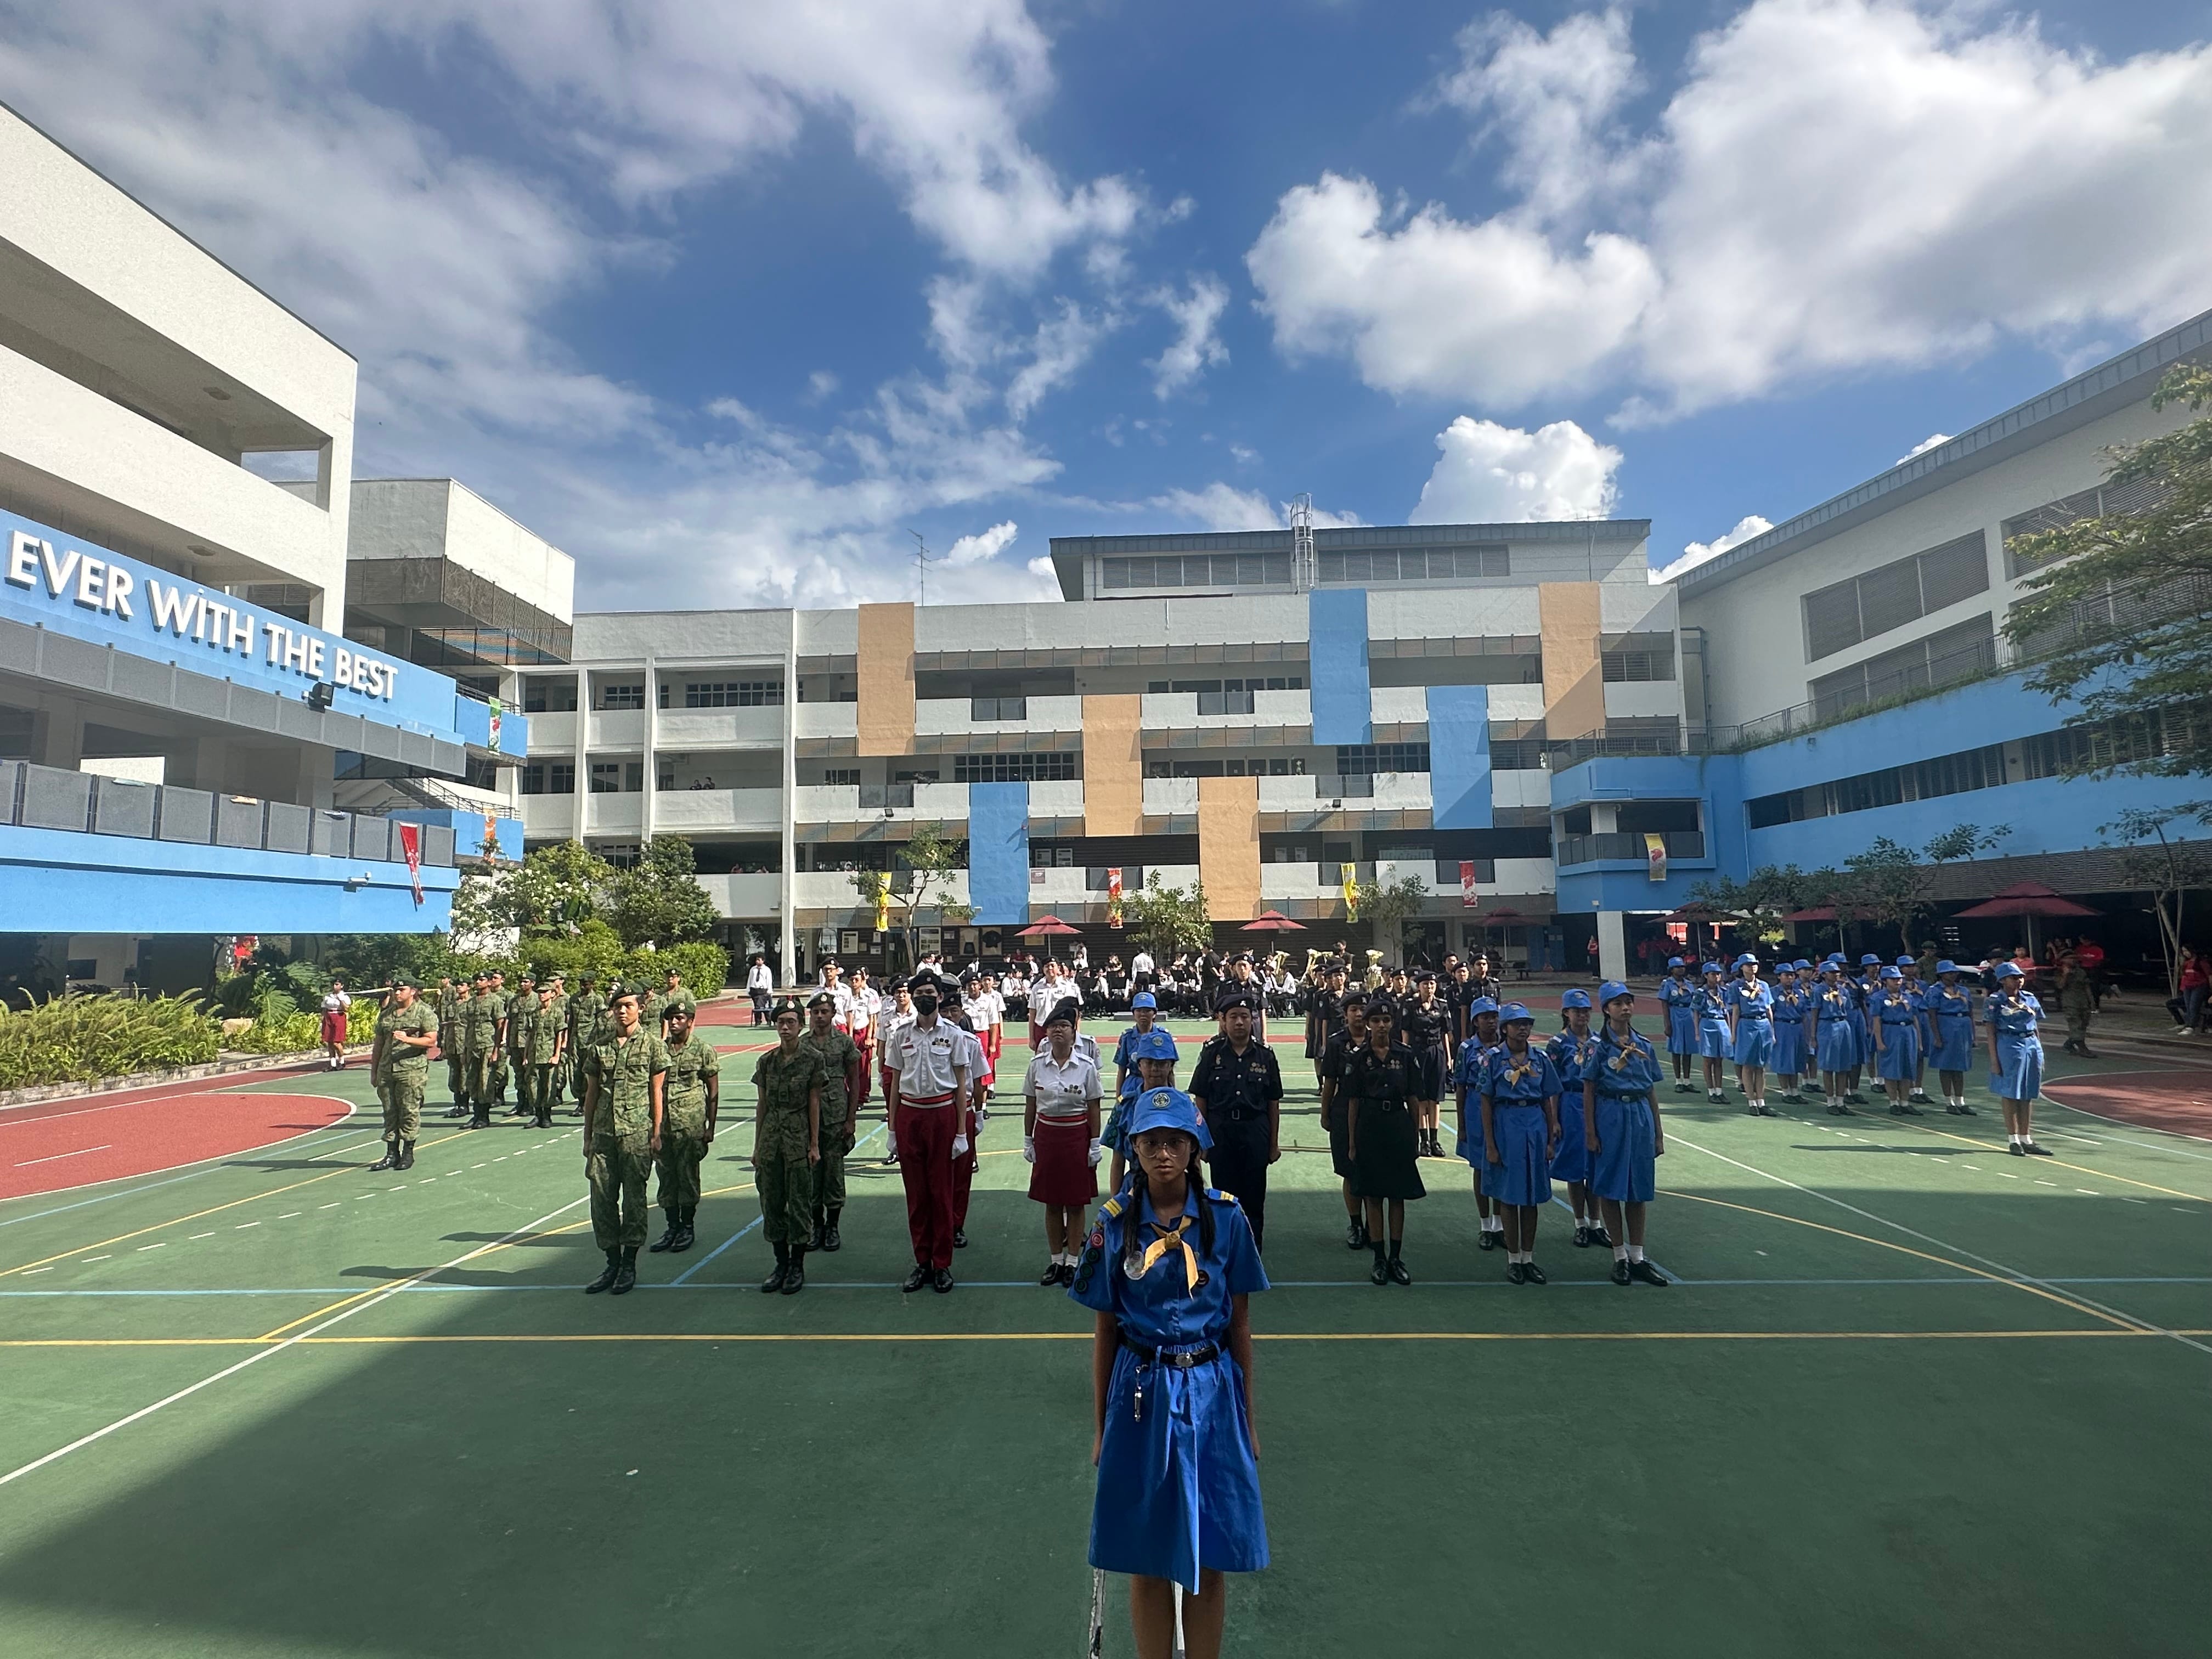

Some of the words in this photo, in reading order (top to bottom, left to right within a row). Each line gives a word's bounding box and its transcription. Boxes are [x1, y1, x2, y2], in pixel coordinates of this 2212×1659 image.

[8, 530, 134, 618] EVER
[264, 622, 325, 677] THE
[333, 647, 398, 699] BEST
